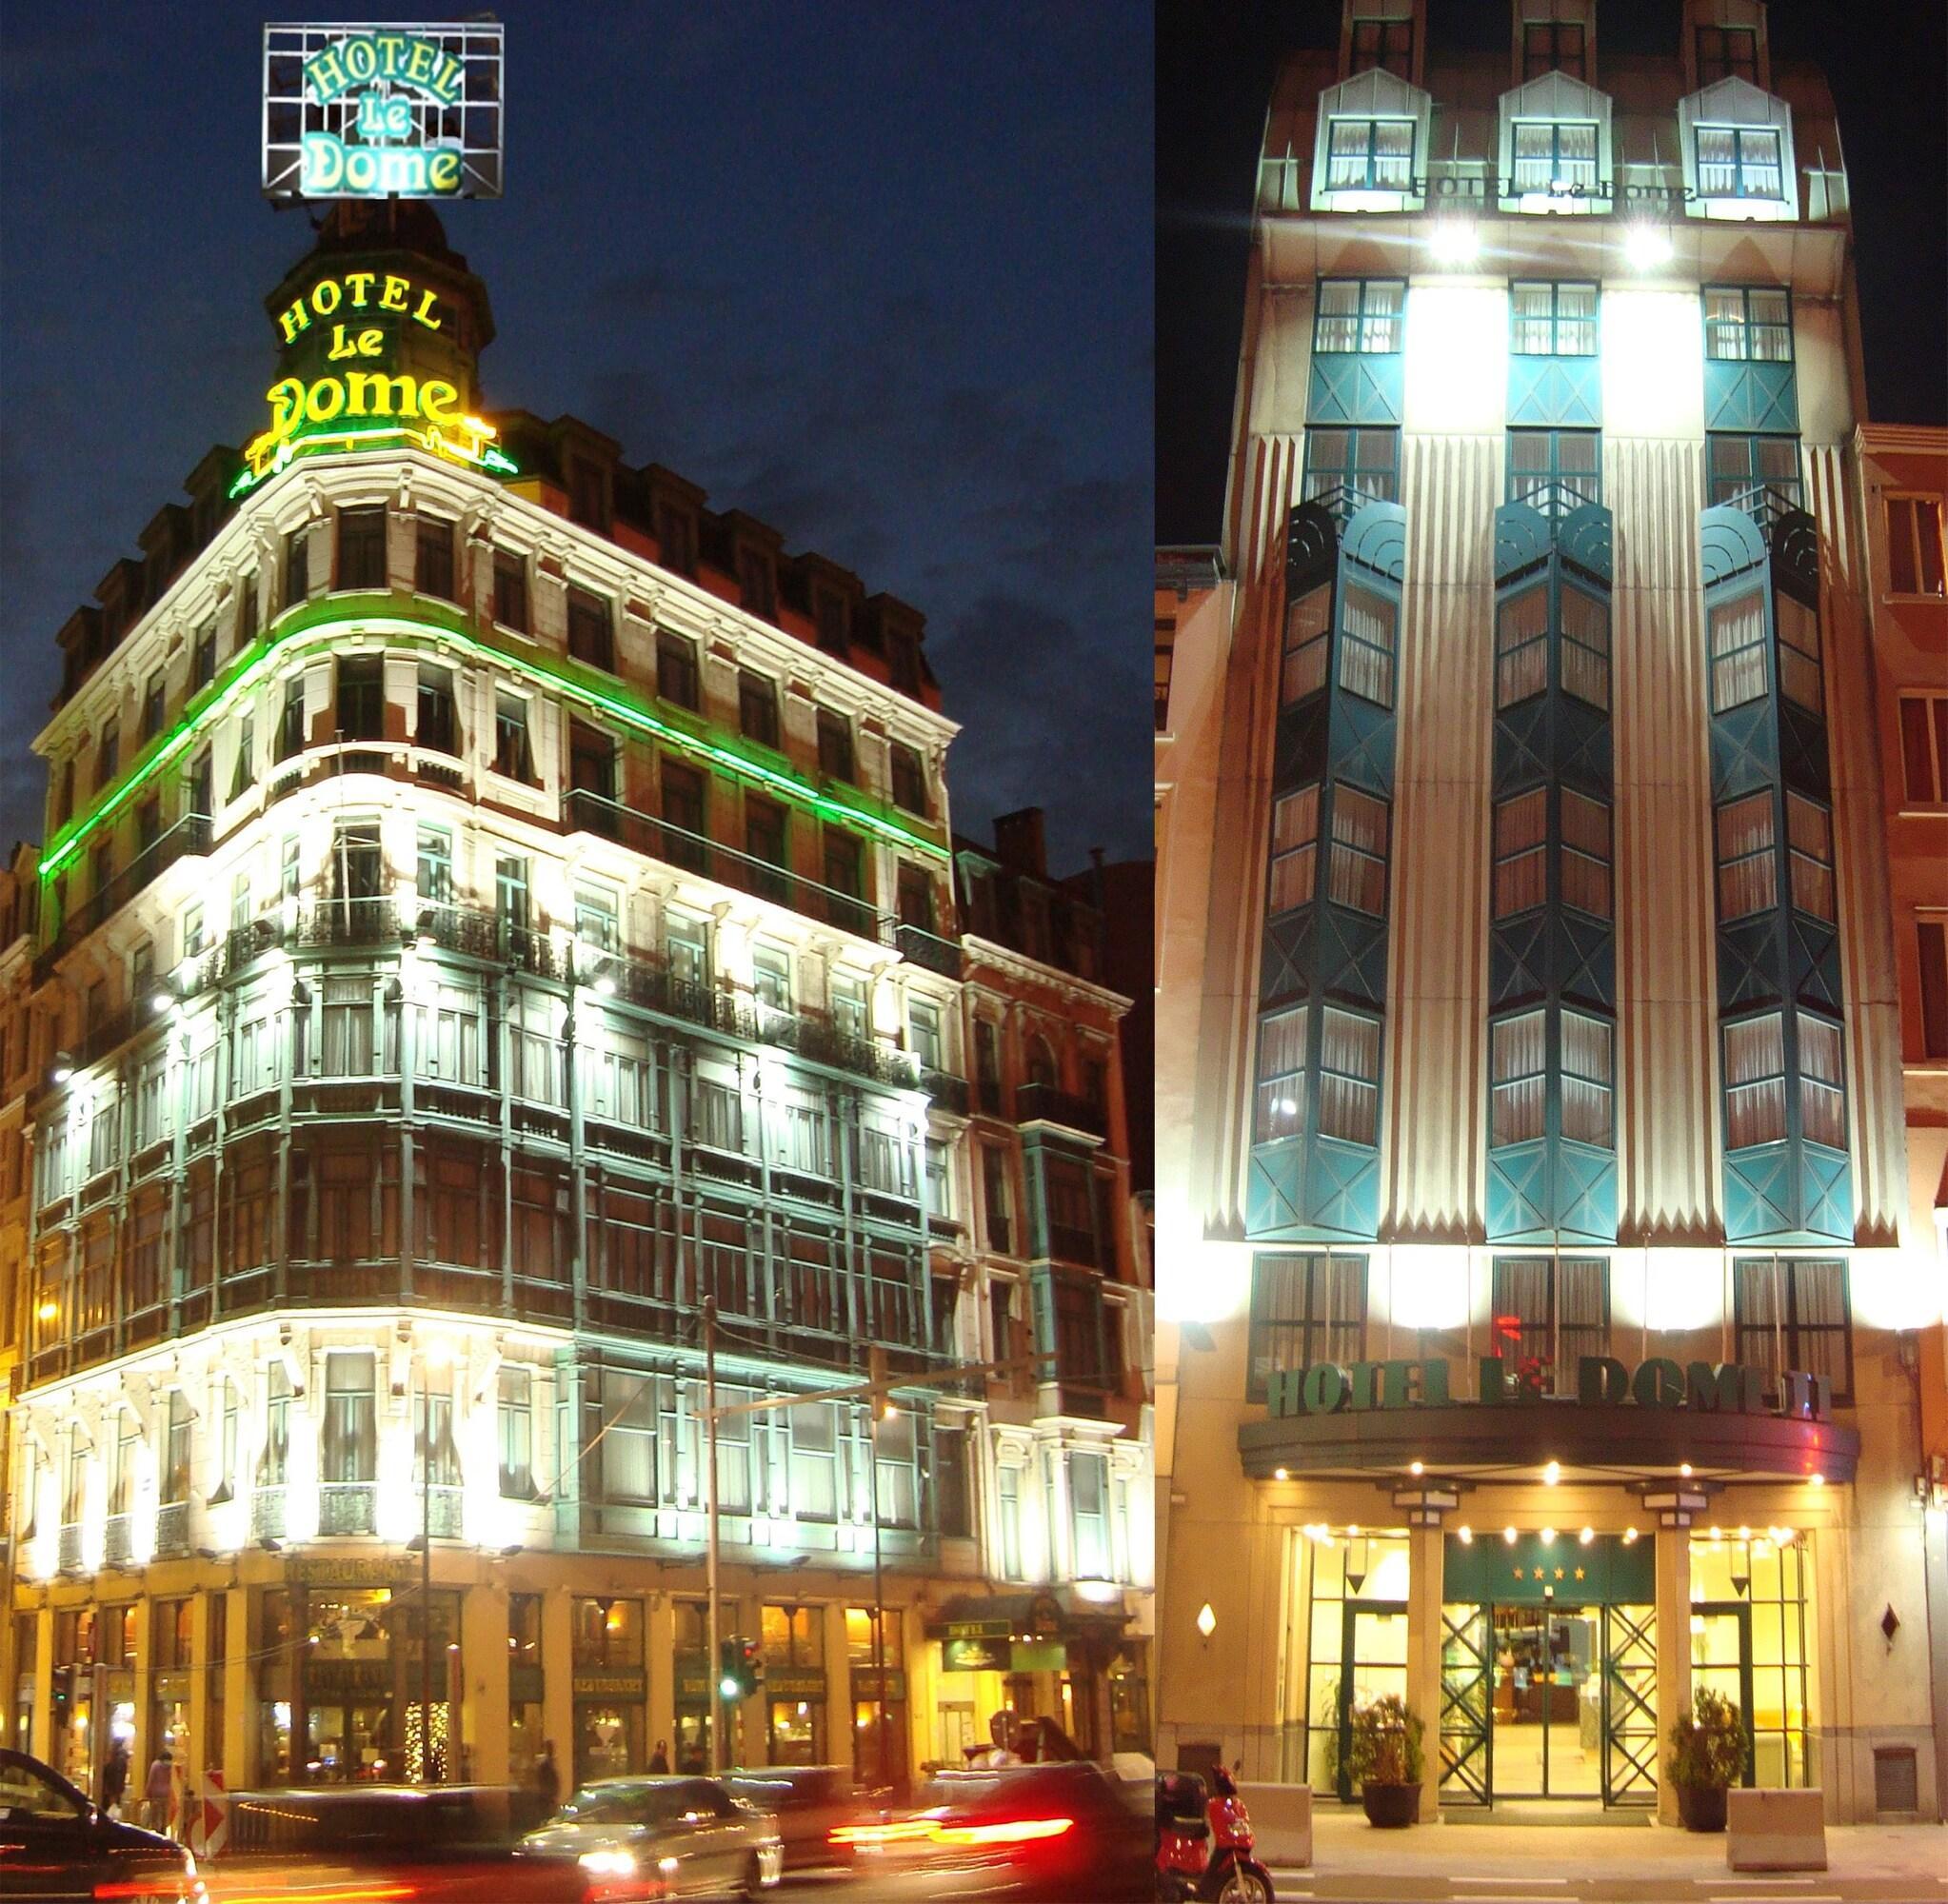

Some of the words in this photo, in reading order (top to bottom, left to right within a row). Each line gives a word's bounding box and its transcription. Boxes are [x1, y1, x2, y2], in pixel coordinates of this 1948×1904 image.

[306, 34, 466, 106] HOTEL
[363, 96, 409, 134] Le
[304, 135, 461, 189] Dome
[1412, 176, 1523, 198] HOTEL
[1600, 180, 1696, 202] Dome
[278, 272, 442, 344] HOTEL
[328, 325, 384, 361] Le
[267, 371, 459, 438] Dome
[1267, 1359, 1448, 1418] HOTEL
